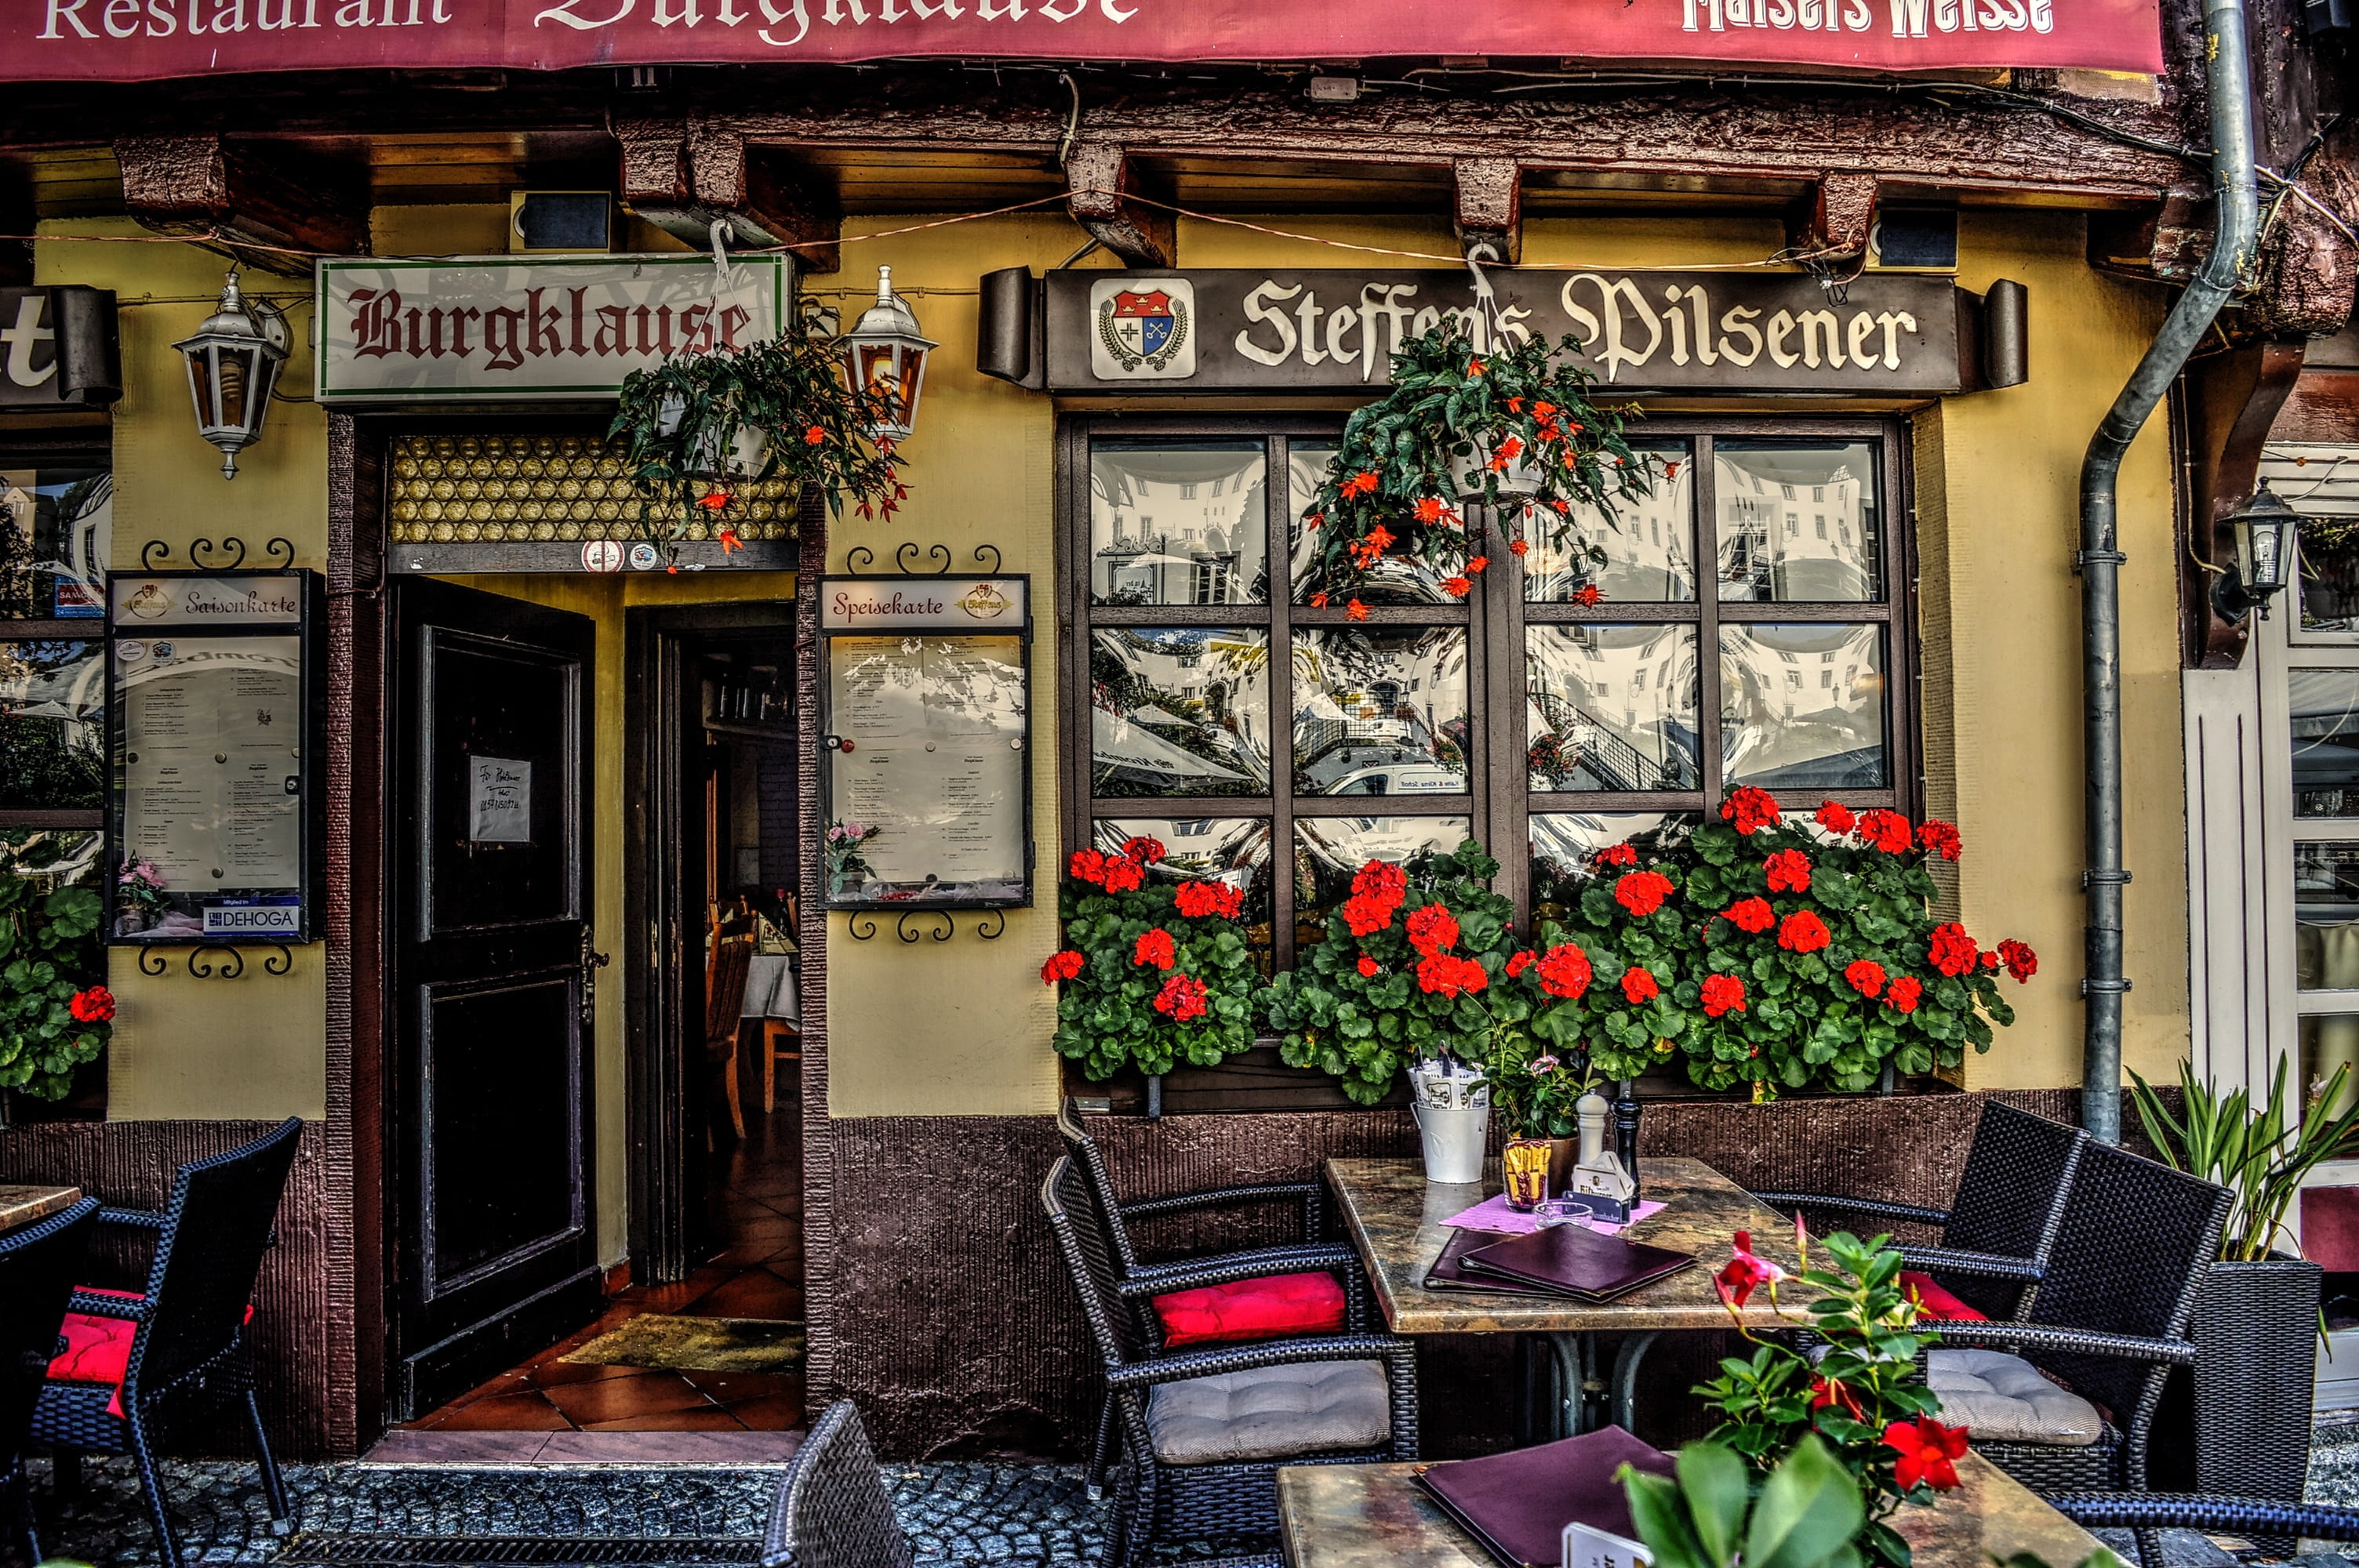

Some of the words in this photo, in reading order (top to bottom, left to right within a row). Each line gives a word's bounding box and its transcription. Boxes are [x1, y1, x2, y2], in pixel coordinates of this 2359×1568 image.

[35, 0, 453, 38] Restaurant
[347, 286, 751, 372] Burgklause
[1234, 279, 1532, 383] Steffens
[1561, 271, 1917, 384] Pilsener
[186, 590, 296, 614] Saisonkarte
[833, 592, 943, 623] Speisekarte
[224, 912, 294, 927] DEHOGA
